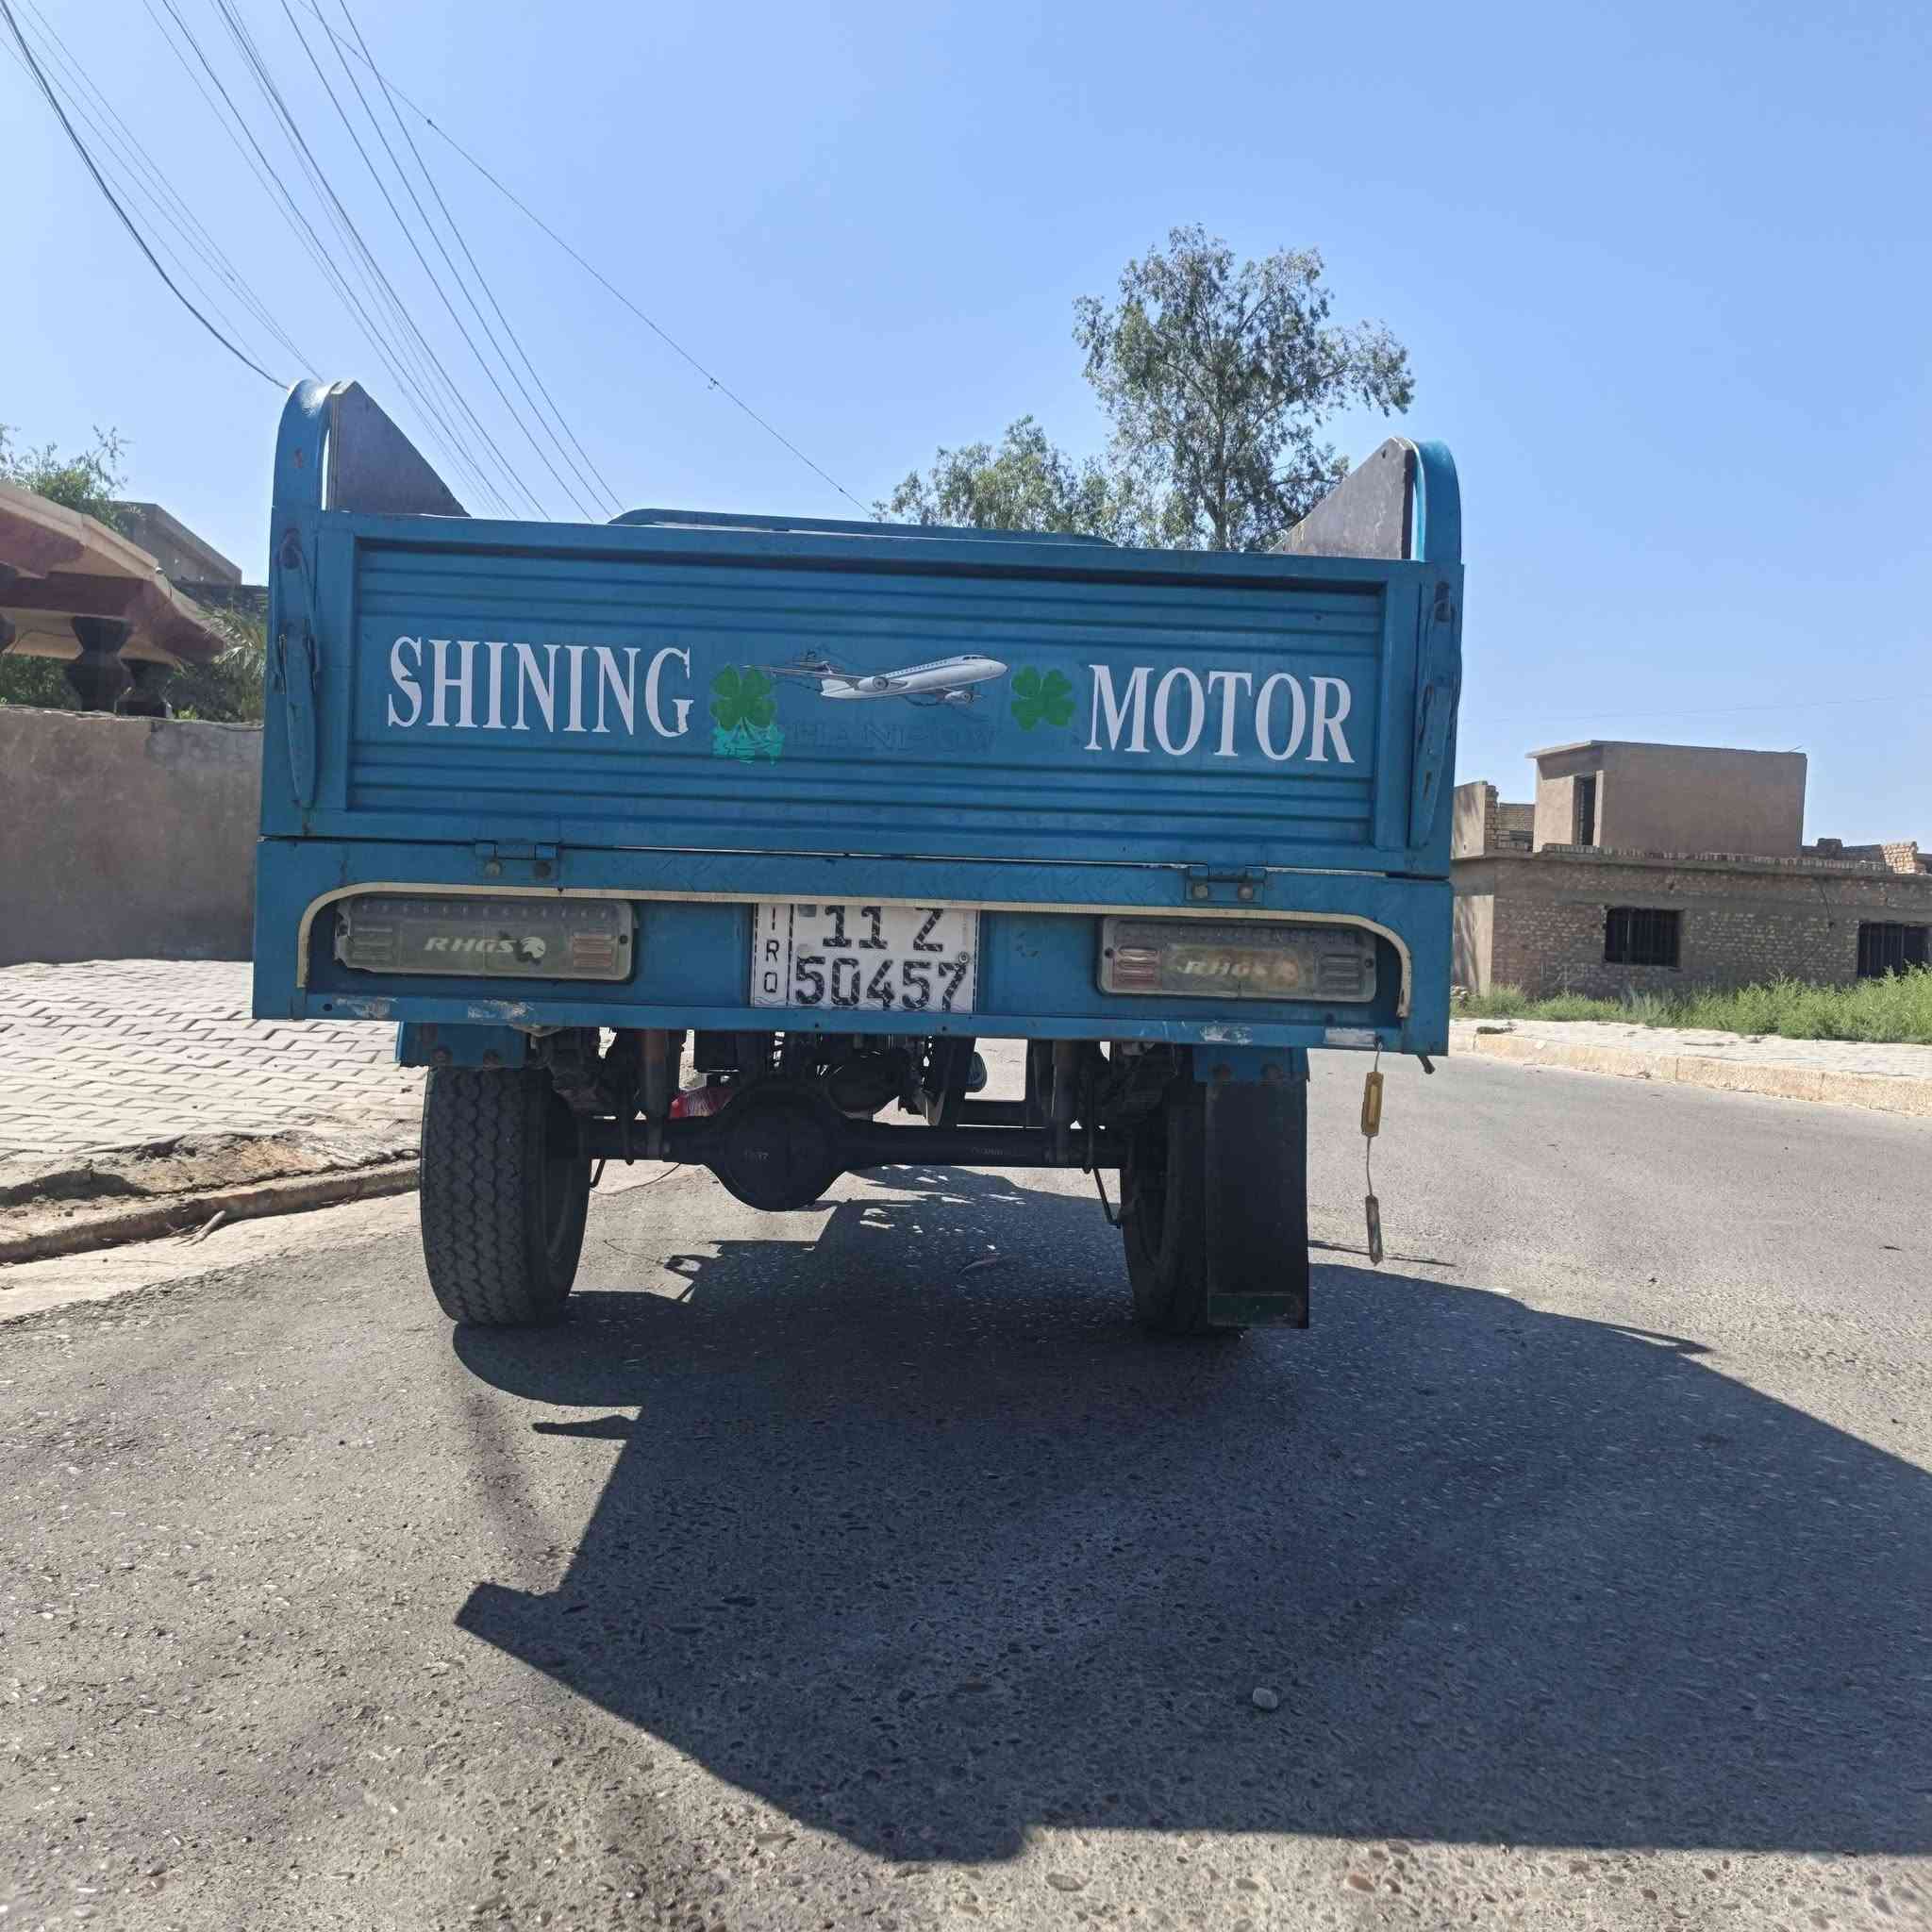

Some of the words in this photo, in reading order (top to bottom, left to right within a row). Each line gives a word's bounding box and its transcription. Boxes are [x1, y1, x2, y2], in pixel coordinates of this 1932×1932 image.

[388, 636, 694, 739] SHINING
[1084, 664, 1356, 763] MOTOR
[823, 906, 888, 949] 11
[913, 908, 943, 952] Z
[795, 956, 967, 1011] 50457
